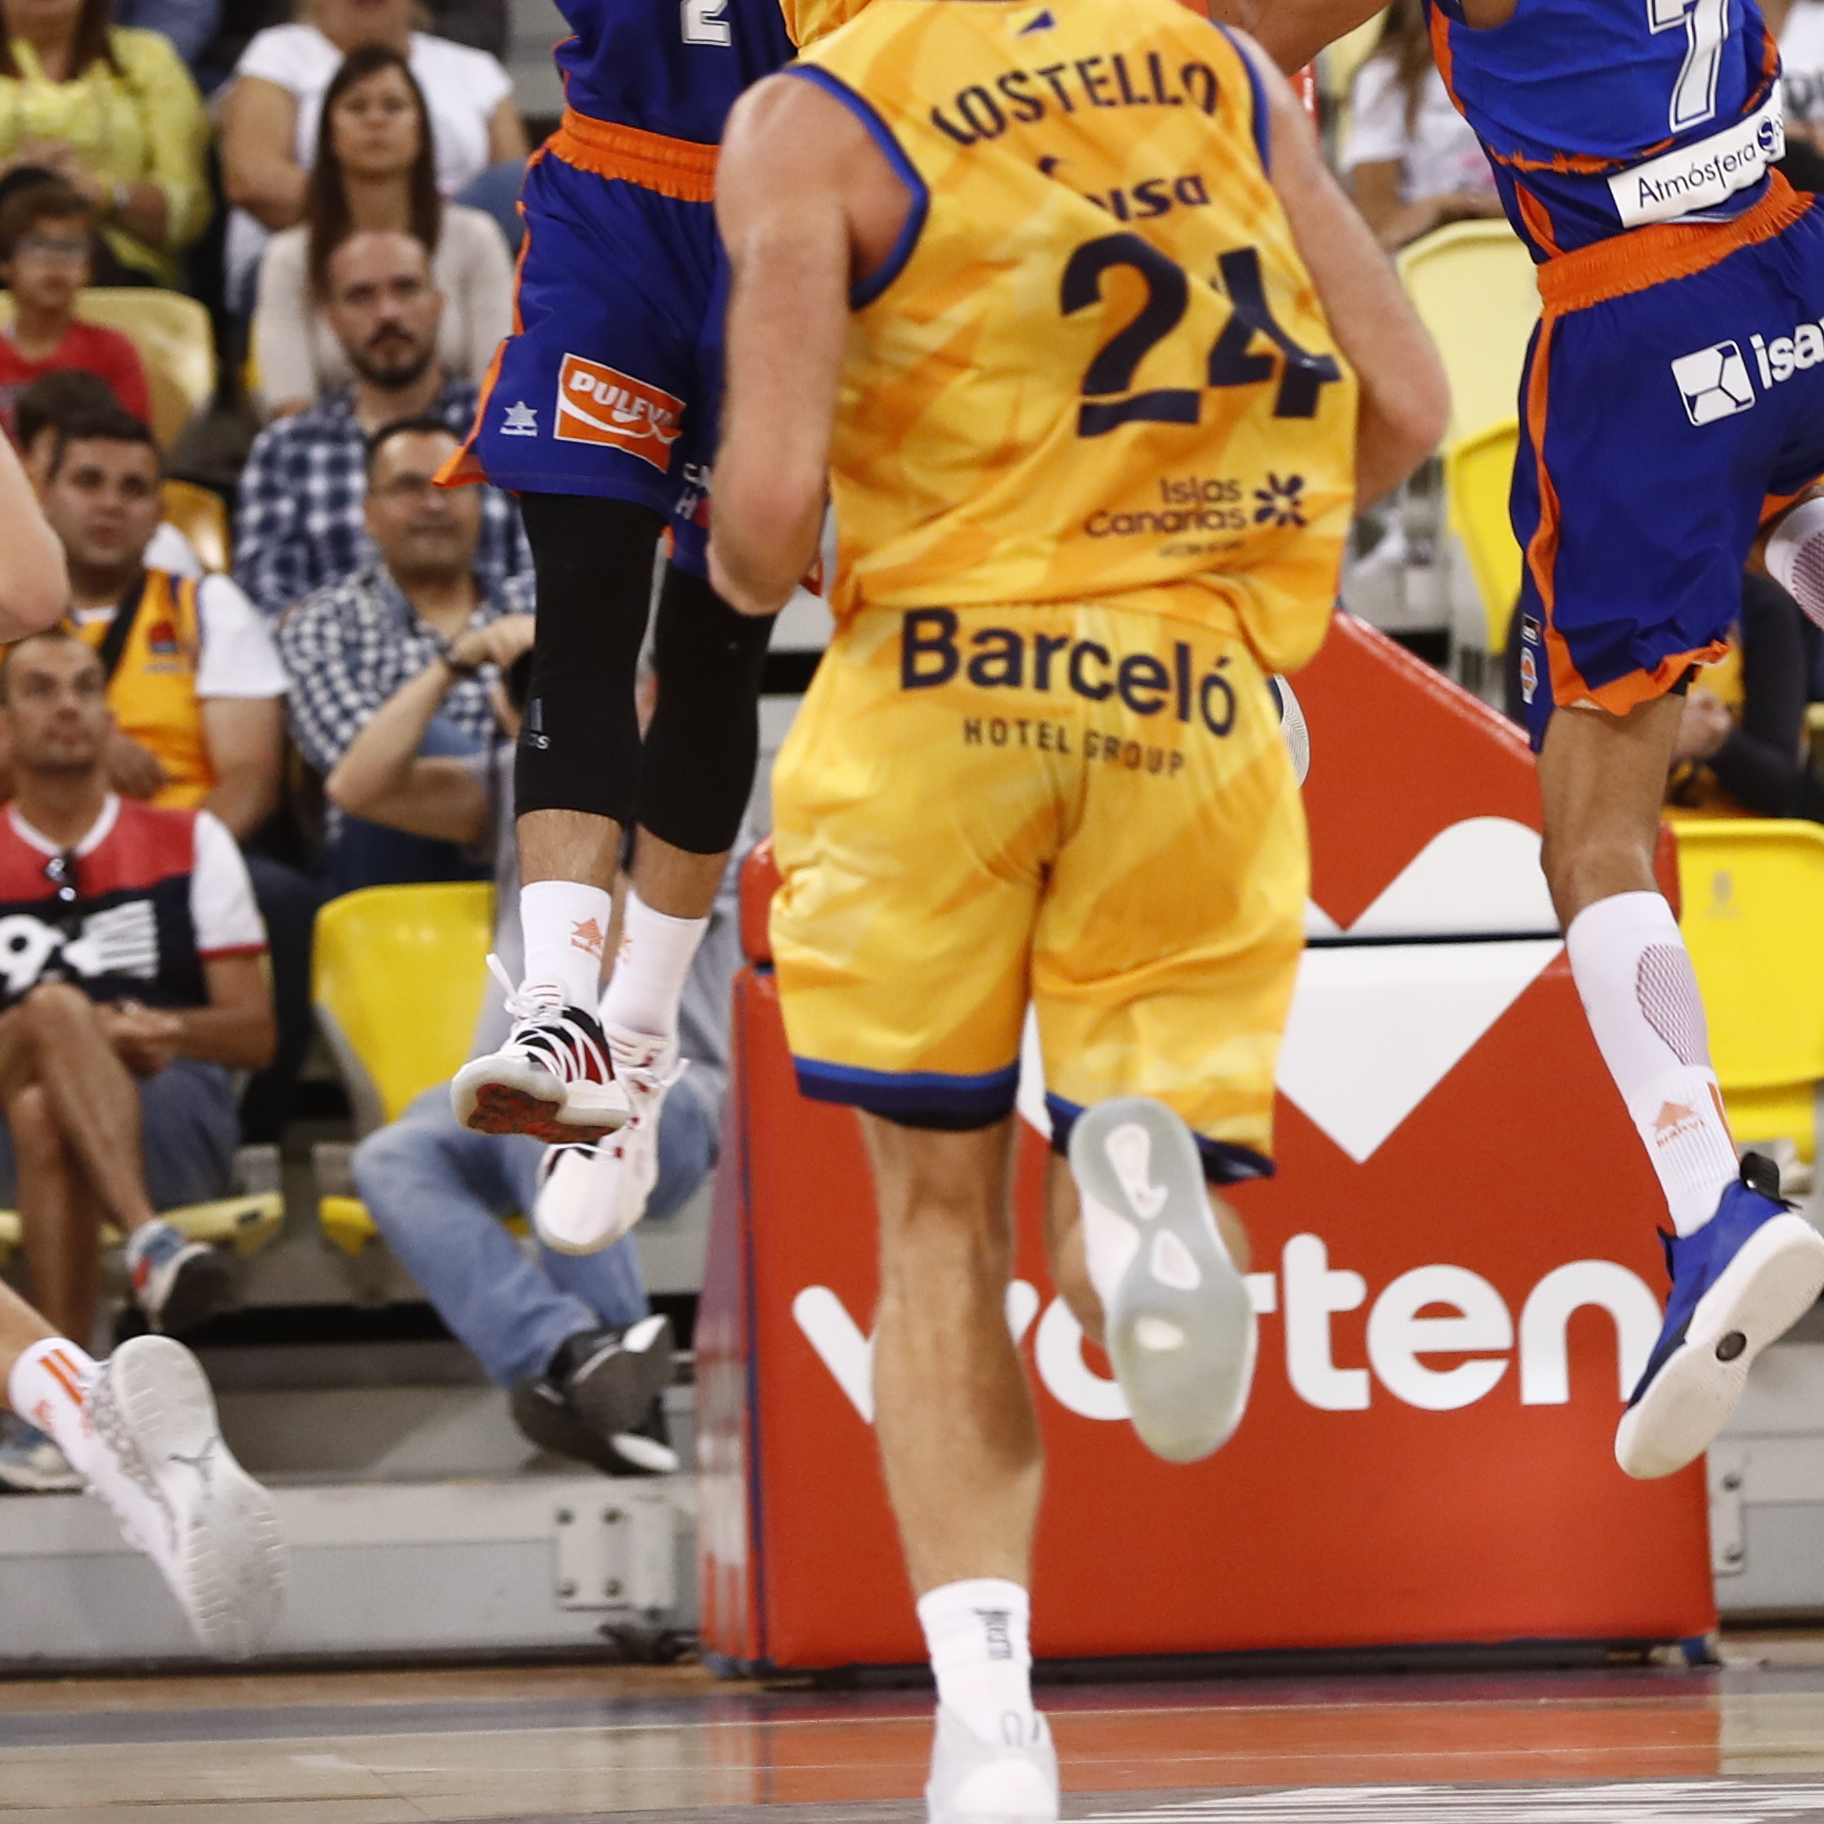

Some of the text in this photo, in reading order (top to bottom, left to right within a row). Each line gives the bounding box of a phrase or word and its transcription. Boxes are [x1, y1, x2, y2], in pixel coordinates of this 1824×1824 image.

[1060, 232, 1343, 438] 24
[1160, 476, 1241, 504] Islas
[1084, 504, 1248, 538] Canarias
[900, 606, 1237, 738] Barceló
[963, 717, 1185, 777] HOTEL GROUP
